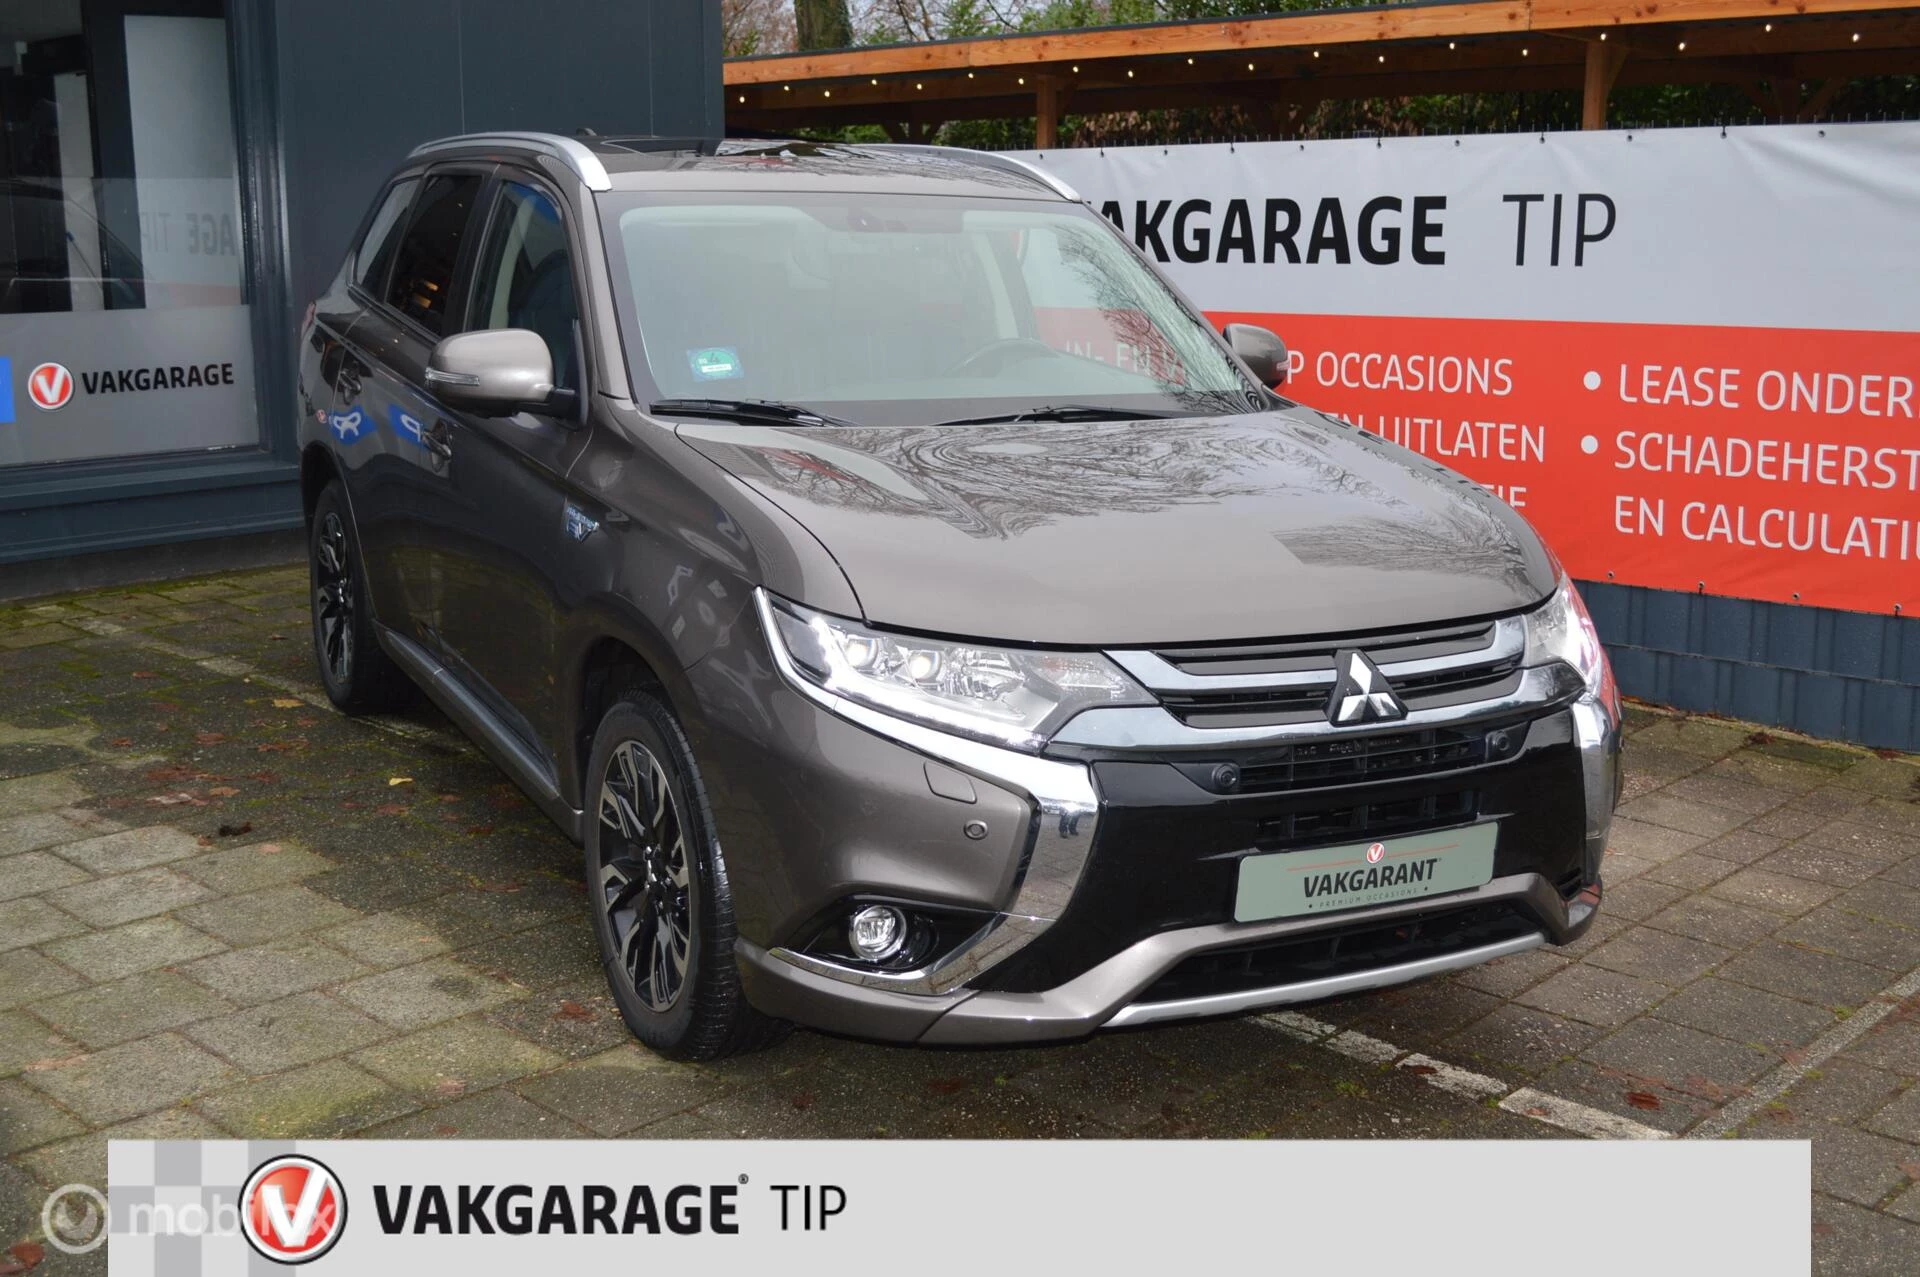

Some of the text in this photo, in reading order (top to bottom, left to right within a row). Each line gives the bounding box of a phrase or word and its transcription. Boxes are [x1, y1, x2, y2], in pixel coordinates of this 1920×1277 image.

[1087, 193, 1617, 267] KGARAGE TIP
[81, 363, 235, 395] VAKGARAGE
[1316, 351, 1513, 396] OCCASIONS
[1619, 364, 1920, 418] LEASE ONDER
[1379, 416, 1545, 463] UITLATEN
[1614, 431, 1920, 490] SCHADEHERST
[1614, 495, 1920, 560] EN CALCULATI
[1303, 858, 1438, 898] VAKGARANT
[1320, 888, 1418, 908] PREMIUM OCCASIONS
